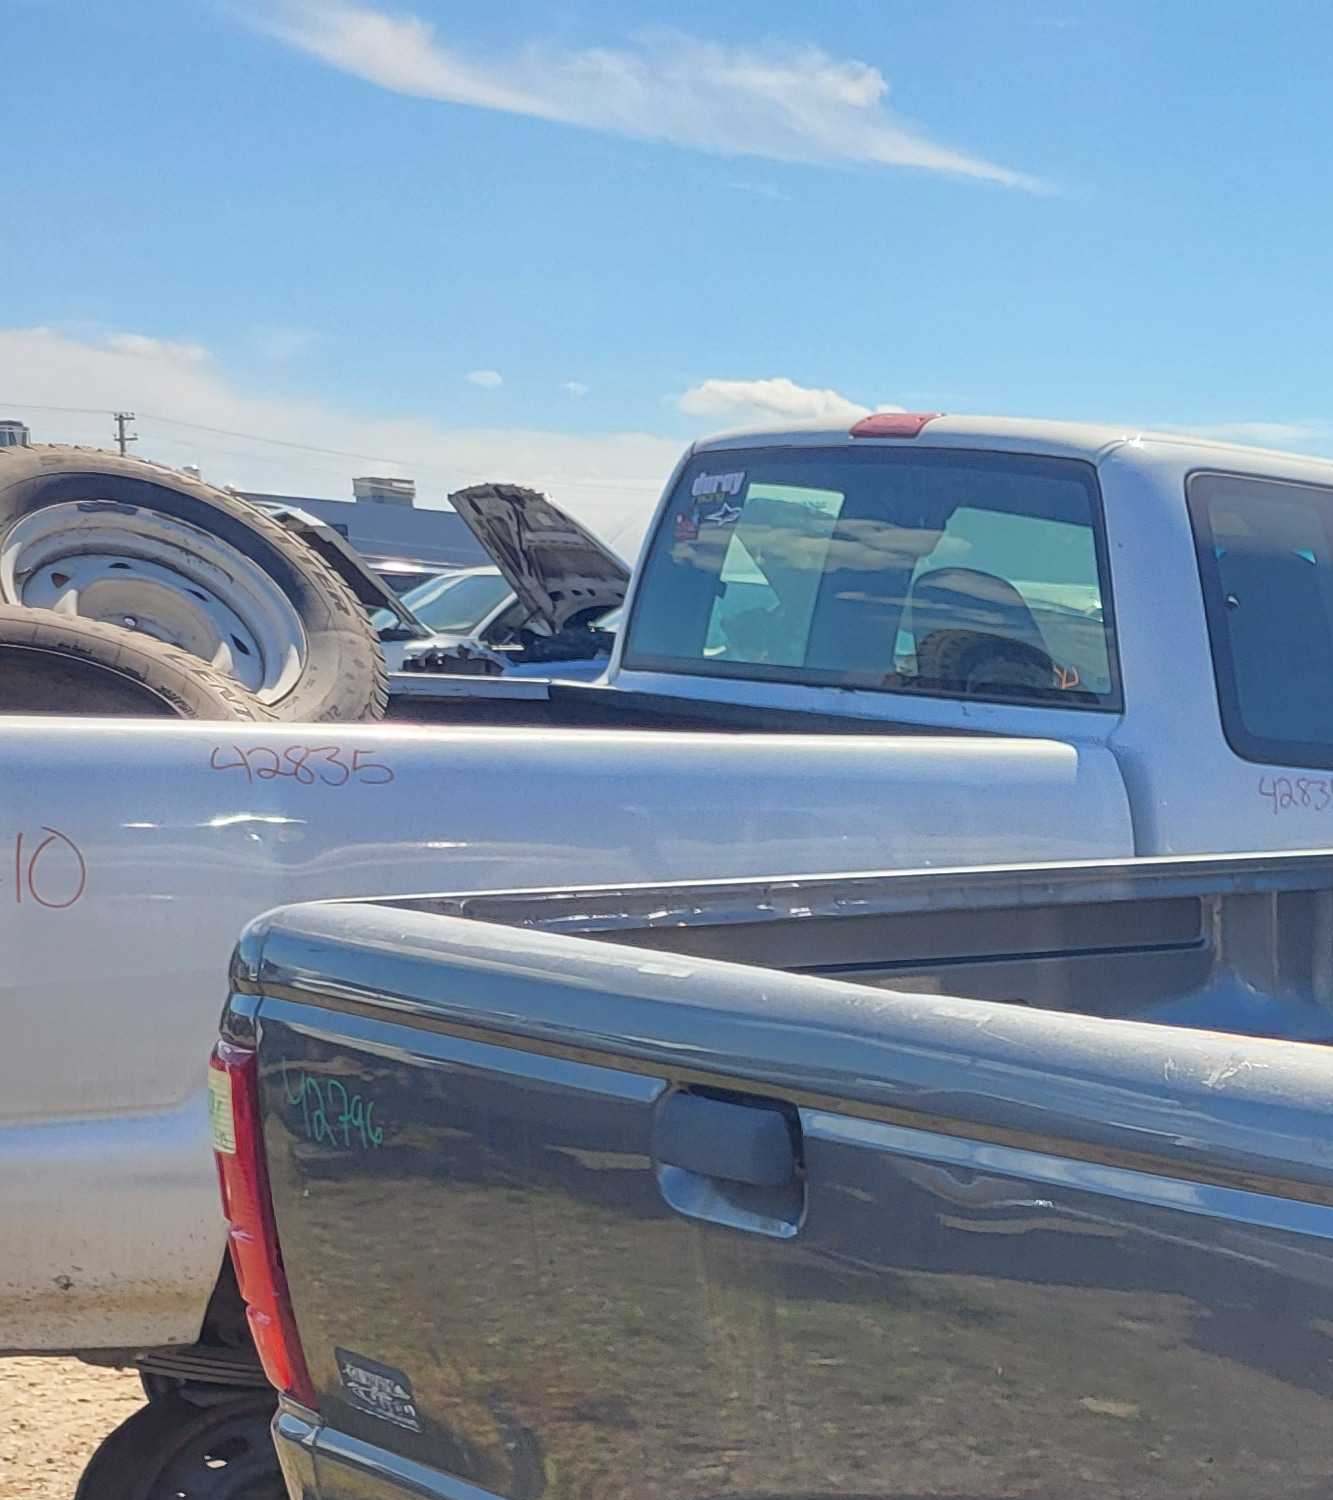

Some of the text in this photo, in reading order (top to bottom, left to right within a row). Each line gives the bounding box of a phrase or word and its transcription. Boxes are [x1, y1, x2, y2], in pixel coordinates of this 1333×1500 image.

[210, 745, 394, 786] 42835
[15, 825, 86, 908] 10
[282, 1056, 383, 1148] 42796
